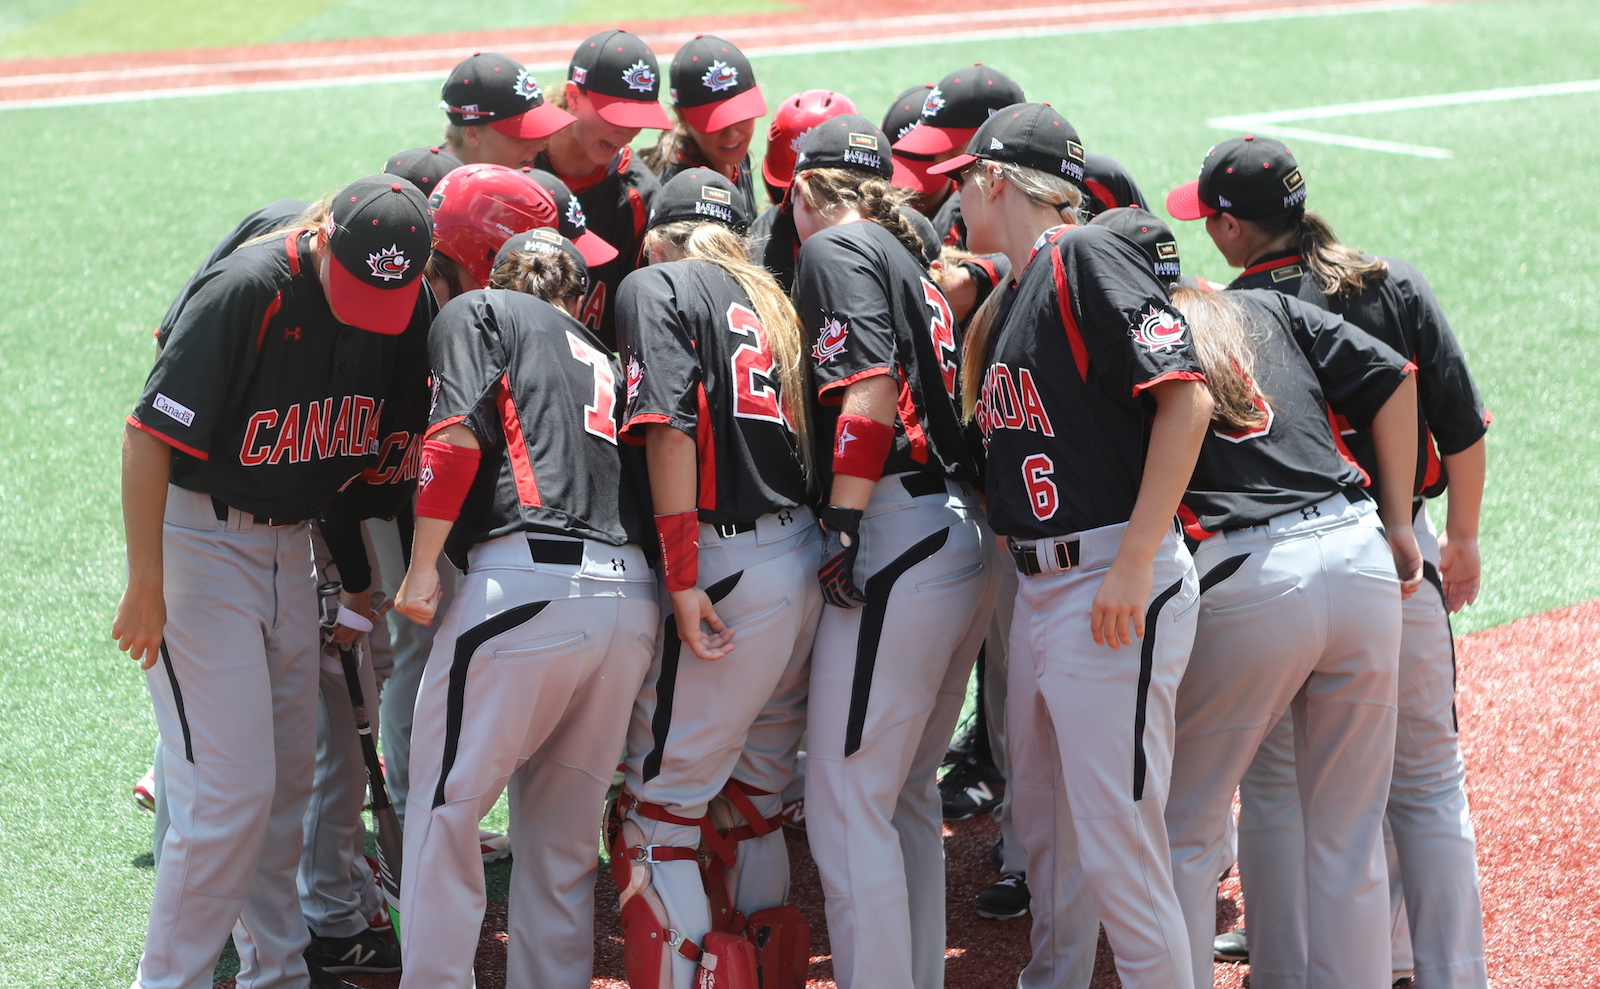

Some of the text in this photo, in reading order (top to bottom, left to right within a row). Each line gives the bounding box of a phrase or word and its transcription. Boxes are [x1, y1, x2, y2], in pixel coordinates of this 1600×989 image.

[844, 149, 881, 165] BASEBALL
[695, 201, 732, 219] BASEBALL
[155, 396, 192, 425] Canada
[565, 329, 618, 446] 7
[239, 394, 385, 466] CANADA
[1021, 452, 1060, 522] 6
